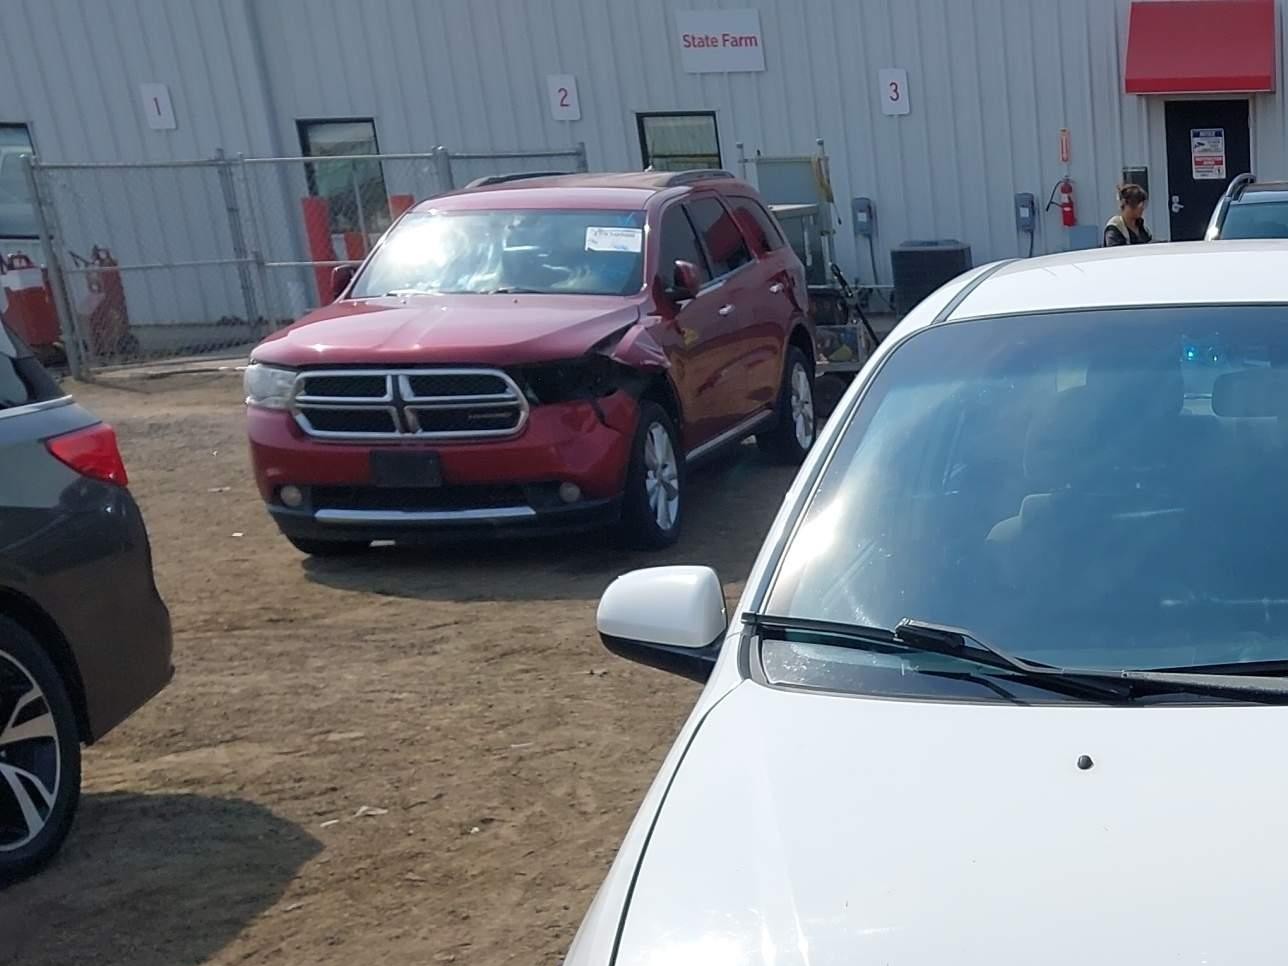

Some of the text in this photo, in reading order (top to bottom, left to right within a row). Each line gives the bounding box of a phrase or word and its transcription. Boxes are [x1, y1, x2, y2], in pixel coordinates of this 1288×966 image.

[682, 33, 758, 48] State Farm
[558, 88, 570, 107] 2
[889, 82, 900, 101] 3
[153, 97, 162, 115] 1
